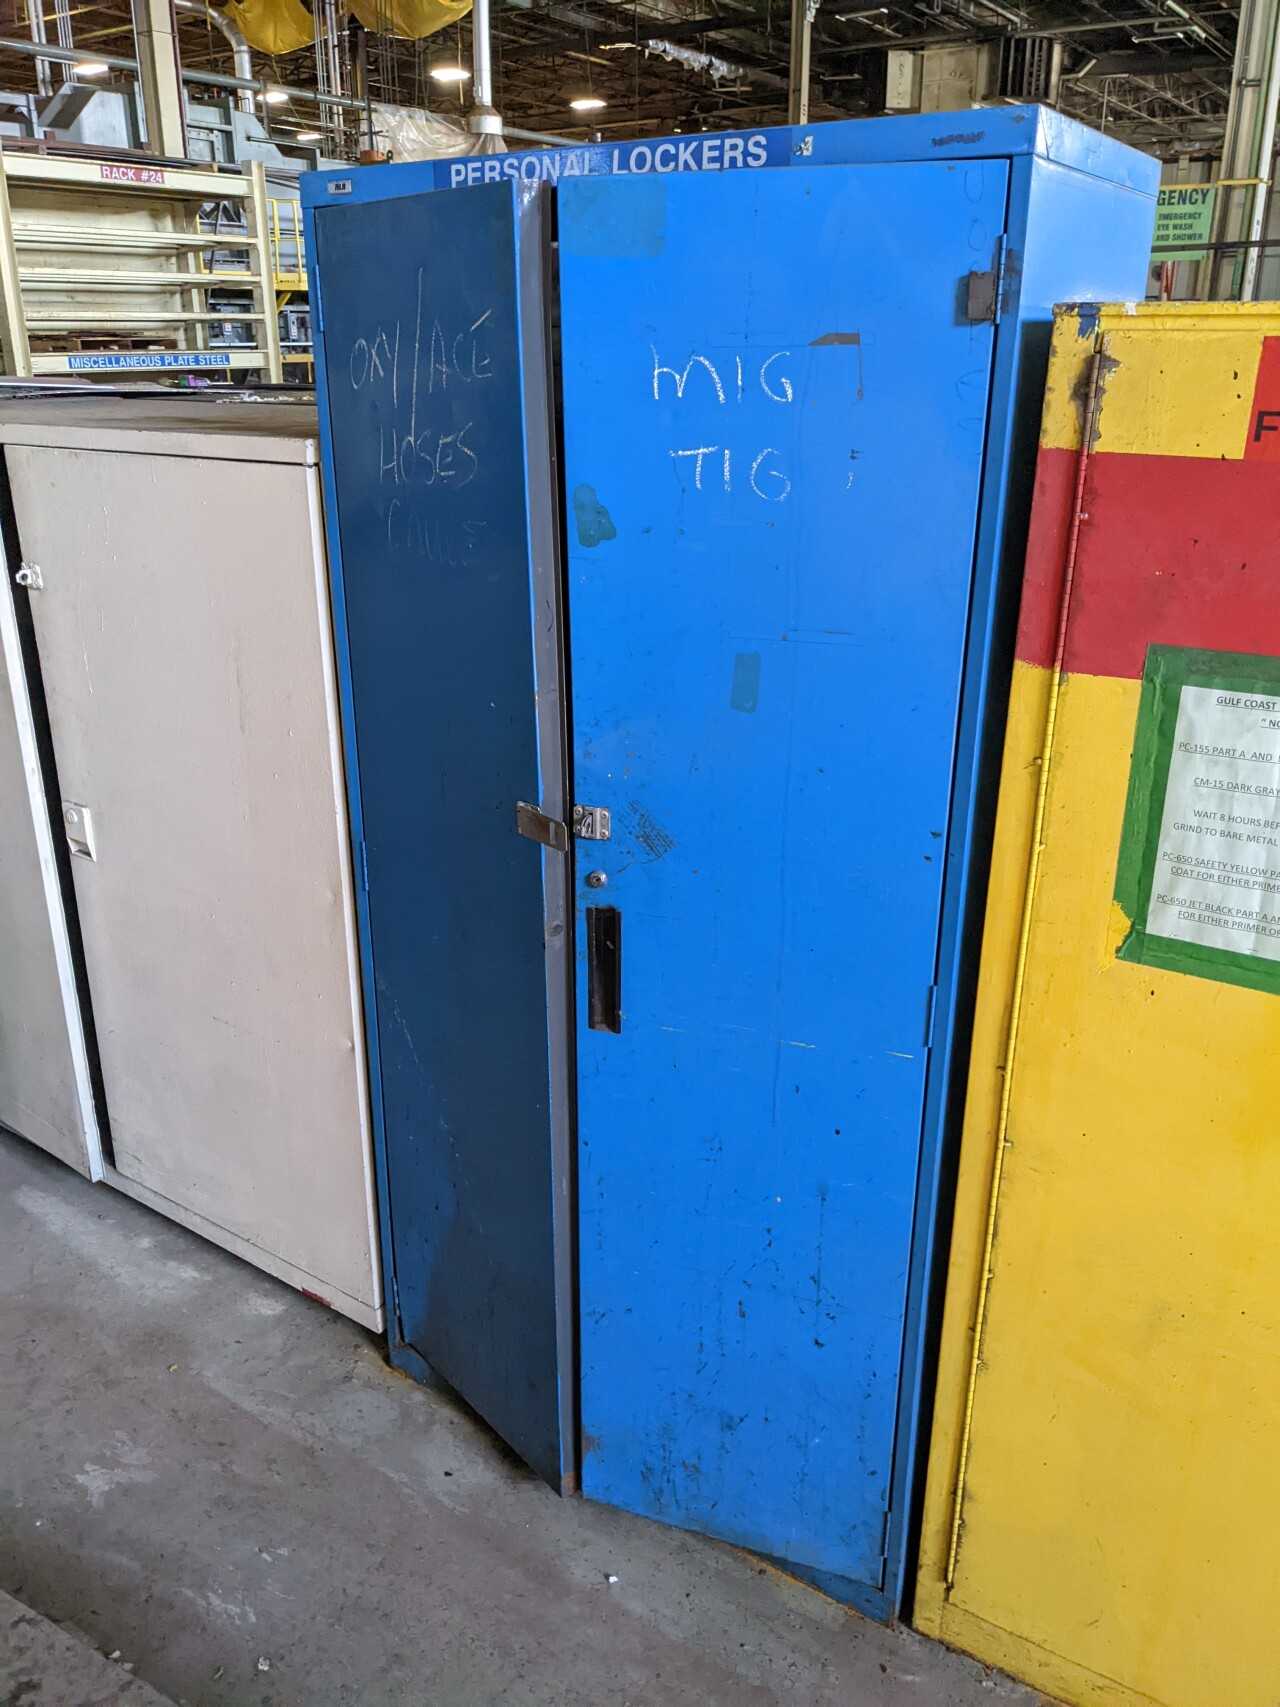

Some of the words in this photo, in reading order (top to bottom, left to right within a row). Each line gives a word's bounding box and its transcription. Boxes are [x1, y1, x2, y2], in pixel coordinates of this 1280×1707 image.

[450, 151, 599, 188] PERSONAL
[612, 135, 768, 175] LOCKERS
[102, 166, 136, 181] RACK
[141, 170, 163, 184] #24
[1172, 223, 1193, 231] WASH
[1172, 233, 1203, 241] SHOWER
[70, 355, 162, 369] MISCELLANEOUS
[164, 354, 197, 367] PLATE
[199, 354, 230, 366] STEEL
[379, 422, 479, 489] HOSES
[668, 445, 792, 502] TIG
[1216, 696, 1242, 706] GULF
[1244, 698, 1277, 711] COAST
[1178, 742, 1210, 753] PC-155
[1213, 746, 1237, 757] PART
[1239, 749, 1246, 758] A
[1250, 751, 1273, 761] AND
[1193, 777, 1224, 788] CM-15
[1227, 781, 1253, 793] DARK
[1255, 785, 1280, 797] GRAY
[1193, 809, 1218, 820] WAIT
[1219, 813, 1226, 822] 8
[1228, 814, 1261, 827] HOURS
[1173, 822, 1203, 834] GRIND
[1205, 827, 1217, 836] TO
[1220, 830, 1244, 841] BARE
[1246, 834, 1279, 847] METAL
[1162, 851, 1193, 863] PC-650
[1195, 857, 1228, 870] SAFETY
[1230, 862, 1268, 876] YELLOW
[1170, 865, 1195, 877] COAT
[1197, 870, 1215, 881] FOR
[1217, 874, 1250, 887] EITHER
[1189, 899, 1203, 909] JET
[1205, 903, 1233, 915] BLACK
[1236, 908, 1260, 920] PART
[1262, 912, 1269, 922] A
[1178, 910, 1196, 921] FOR
[1198, 913, 1230, 927] EITHER
[1231, 921, 1267, 934] PRIMER
